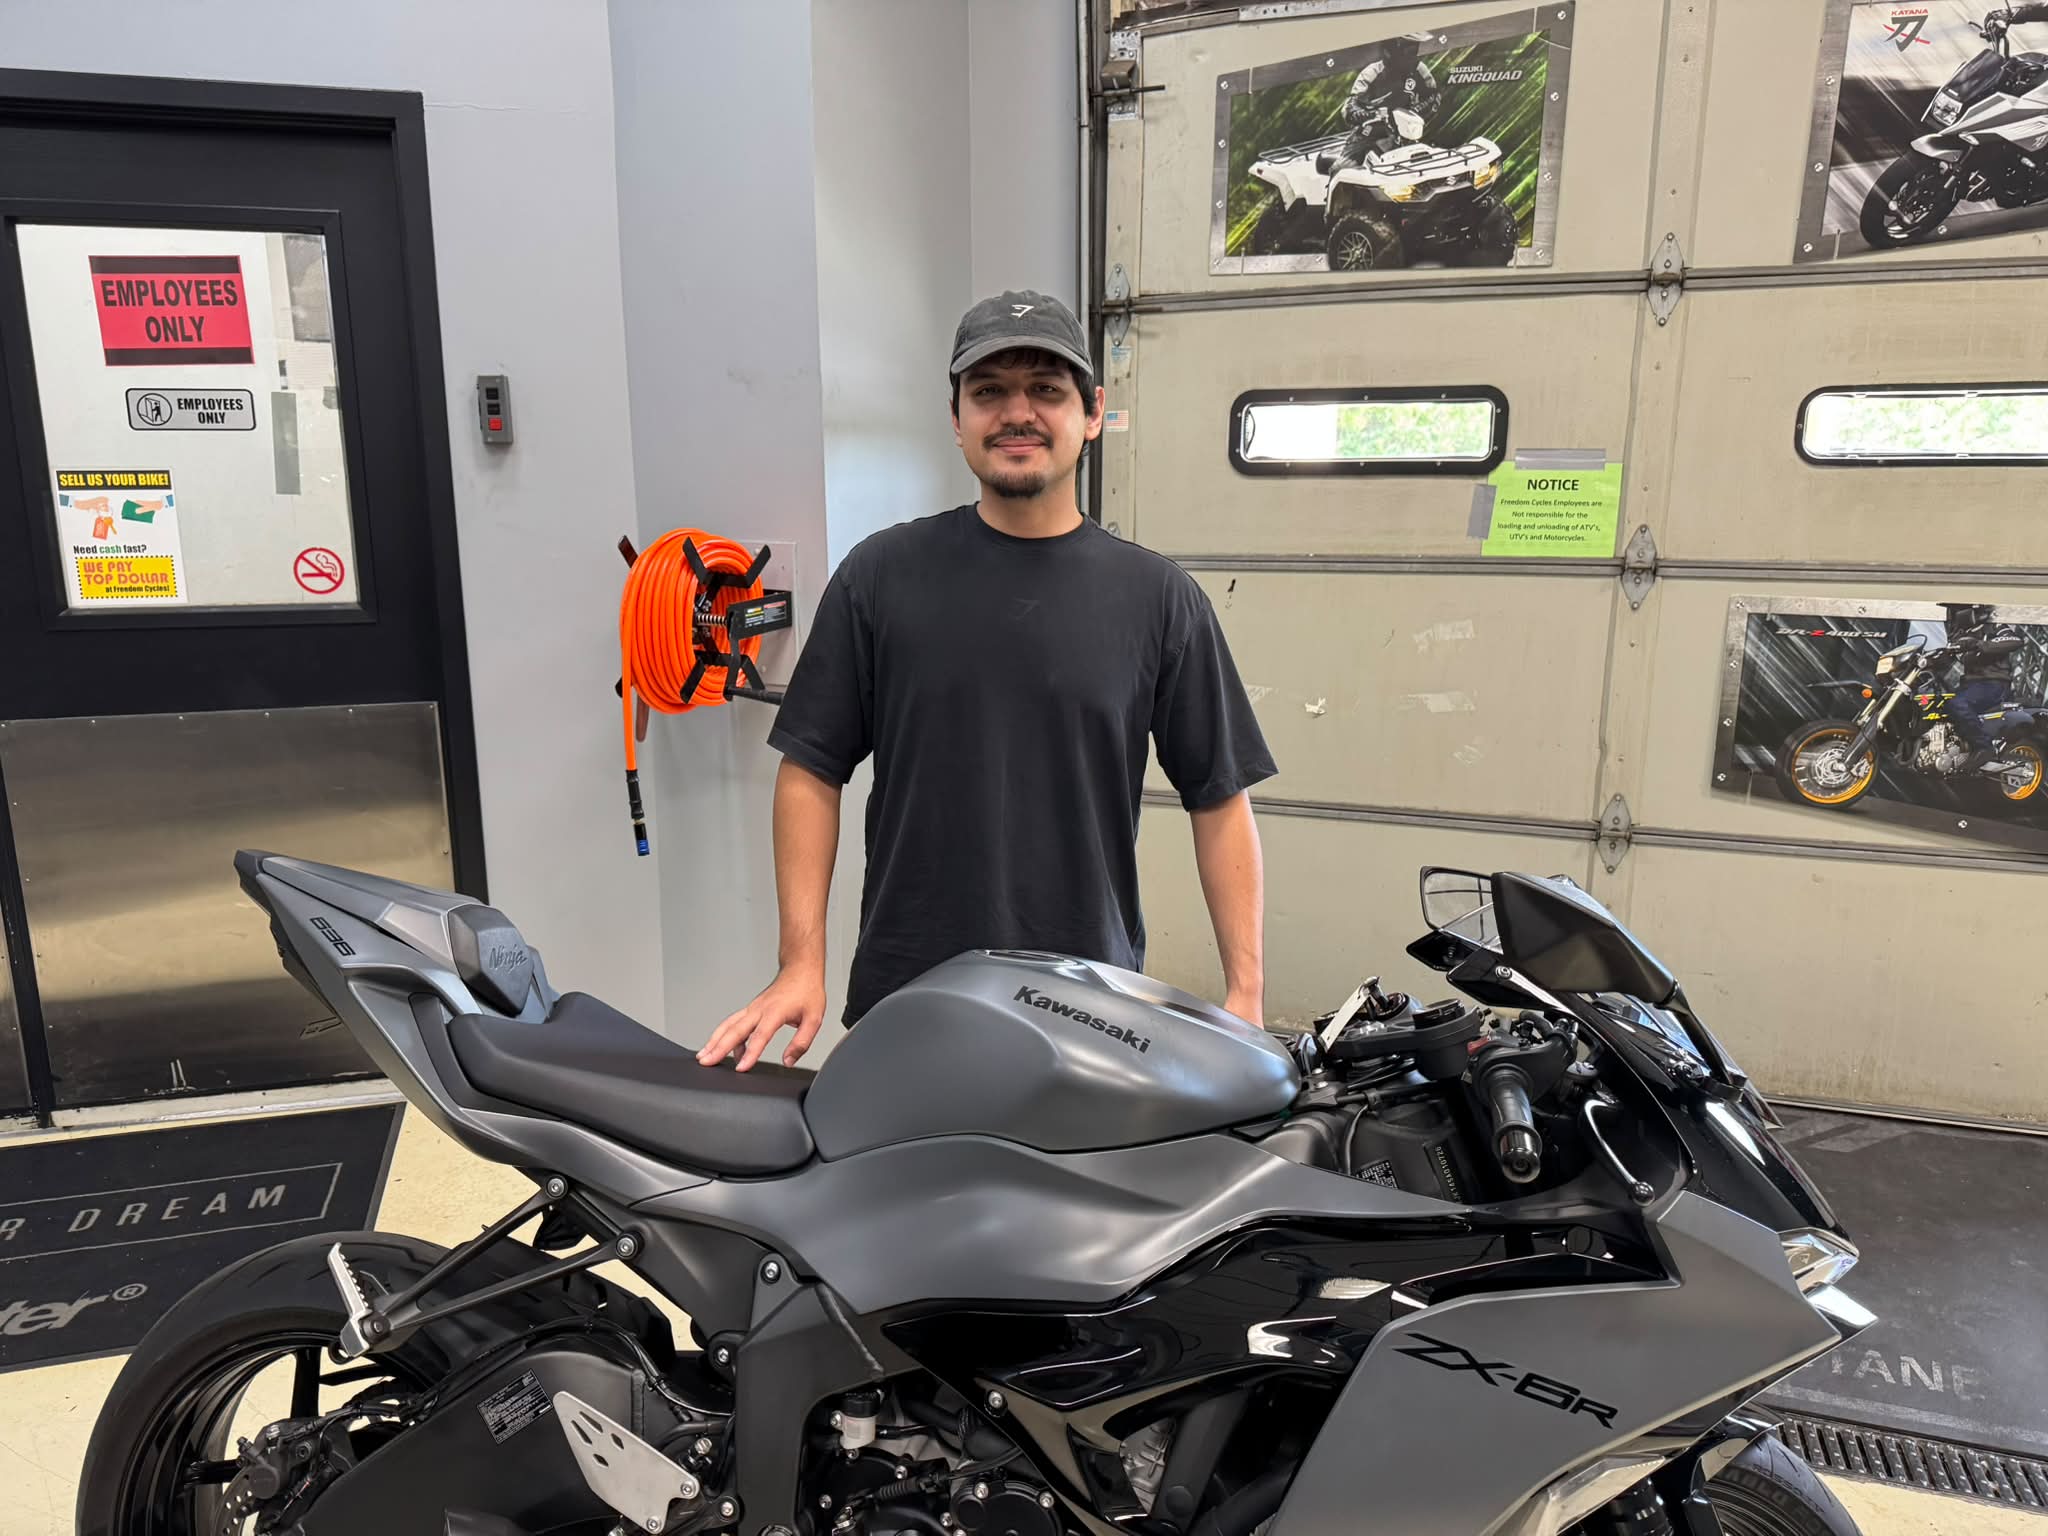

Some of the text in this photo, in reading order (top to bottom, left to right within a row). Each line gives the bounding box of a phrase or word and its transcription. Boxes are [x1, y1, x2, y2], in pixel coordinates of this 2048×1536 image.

[1449, 65, 1483, 73] SUZUKI
[1447, 70, 1523, 84] KINGQUAD
[101, 279, 238, 307] EMPLOYEES
[145, 316, 205, 343] ONLY
[176, 398, 244, 411] EMPLOYEES
[197, 411, 226, 424] ONLY
[59, 473, 169, 487] SELL US YOUR BIKE!
[1527, 478, 1580, 492] NOTICE
[1500, 498, 1530, 506] Freedom
[1531, 499, 1552, 507] Cycles
[1553, 499, 1590, 507] Employees
[1525, 511, 1564, 519] responsible
[1497, 522, 1522, 531] loading
[1536, 523, 1570, 532] unloading
[1529, 533, 1543, 541] and
[73, 544, 147, 554] Need cash fast?
[83, 561, 133, 573] WE PAY
[83, 572, 169, 585] TOP DOLLAR
[113, 585, 144, 593] Freedom
[144, 585, 170, 593] Cycles!
[310, 916, 356, 958] 636
[488, 943, 529, 974] Ninja
[1013, 985, 1151, 1054] Kawasaki
[67, 1184, 286, 1233] DREAM
[1393, 1333, 1619, 1430] ZX-6R
